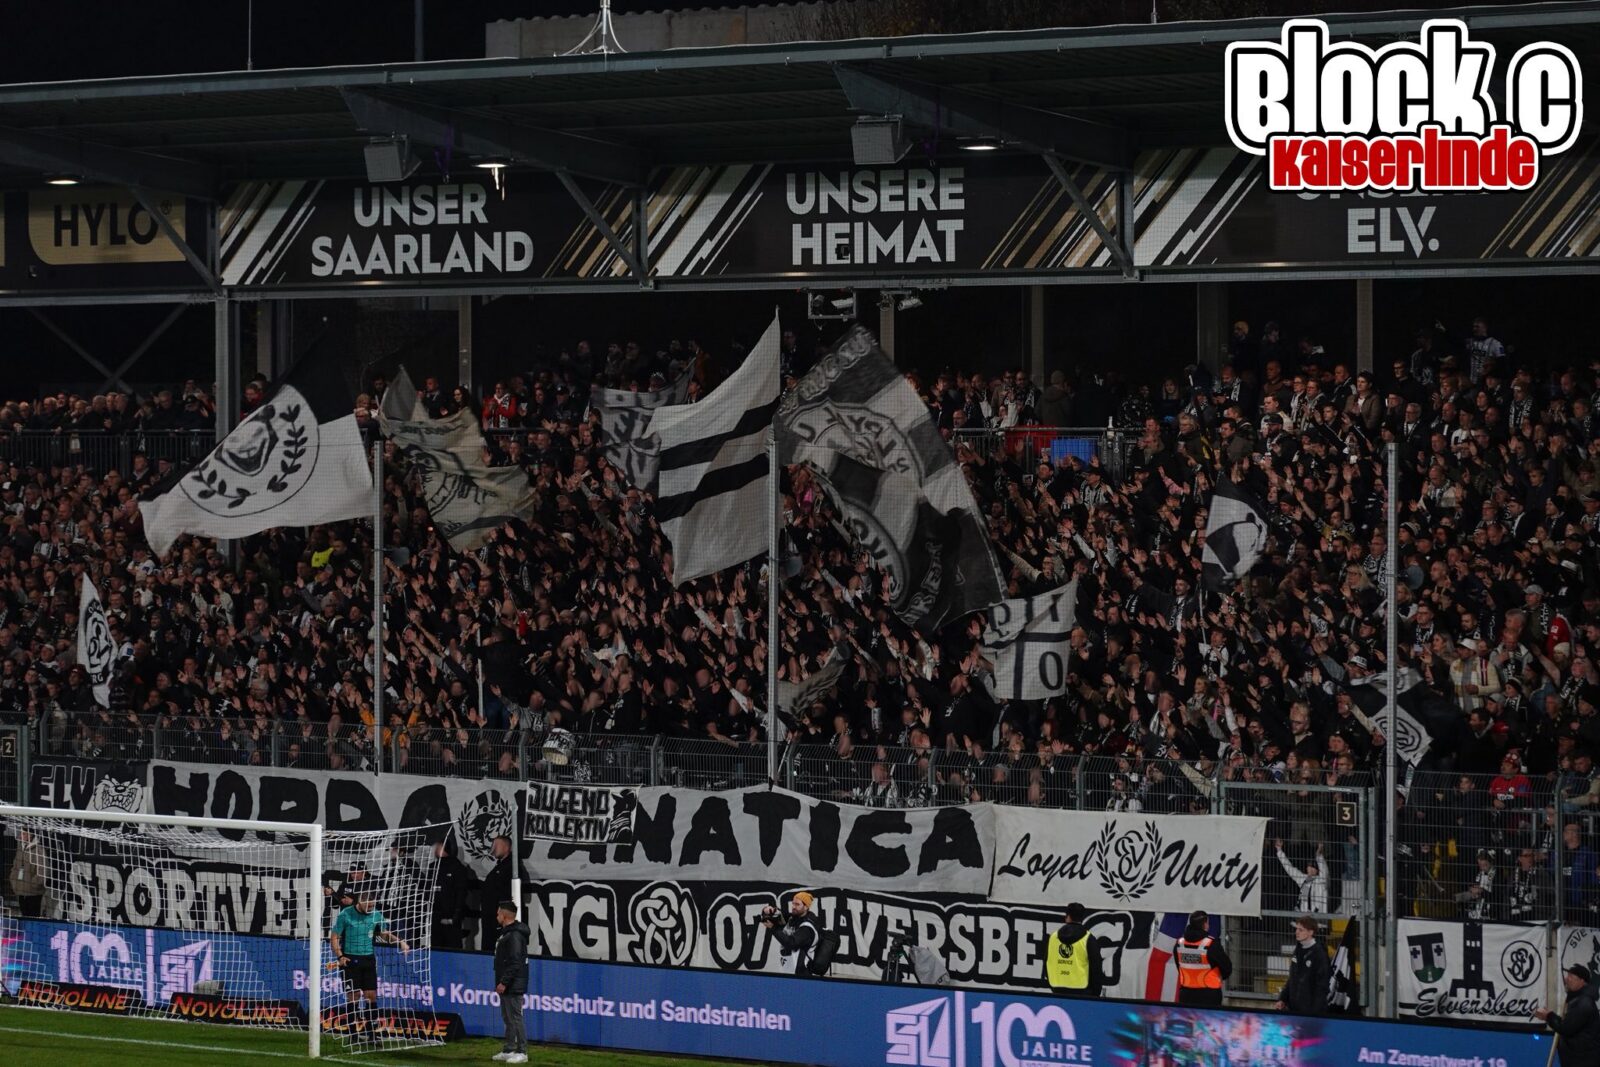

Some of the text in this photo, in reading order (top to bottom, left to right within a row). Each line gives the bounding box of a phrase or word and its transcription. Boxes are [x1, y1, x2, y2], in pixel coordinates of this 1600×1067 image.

[353, 183, 489, 227] UNSER
[786, 167, 965, 215] UNSERE
[791, 218, 965, 265] HEIMAT
[1346, 206, 1441, 258] ELV.
[311, 231, 535, 277] SAARLAND
[529, 781, 610, 815] JUGEND
[1341, 806, 1351, 821] 3
[525, 812, 612, 841] KOLLEKTIV
[997, 832, 1098, 892] Loyal
[1161, 840, 1260, 903] Unity
[89, 965, 143, 981] JAHRE
[619, 1000, 656, 1020] und
[660, 999, 792, 1031] Sandstrahlen
[1415, 969, 1540, 1022] Elversberg
[1021, 1040, 1092, 1061] JAHRE
[1357, 1047, 1384, 1064] Am
[1387, 1049, 1484, 1067] Zementwerk
